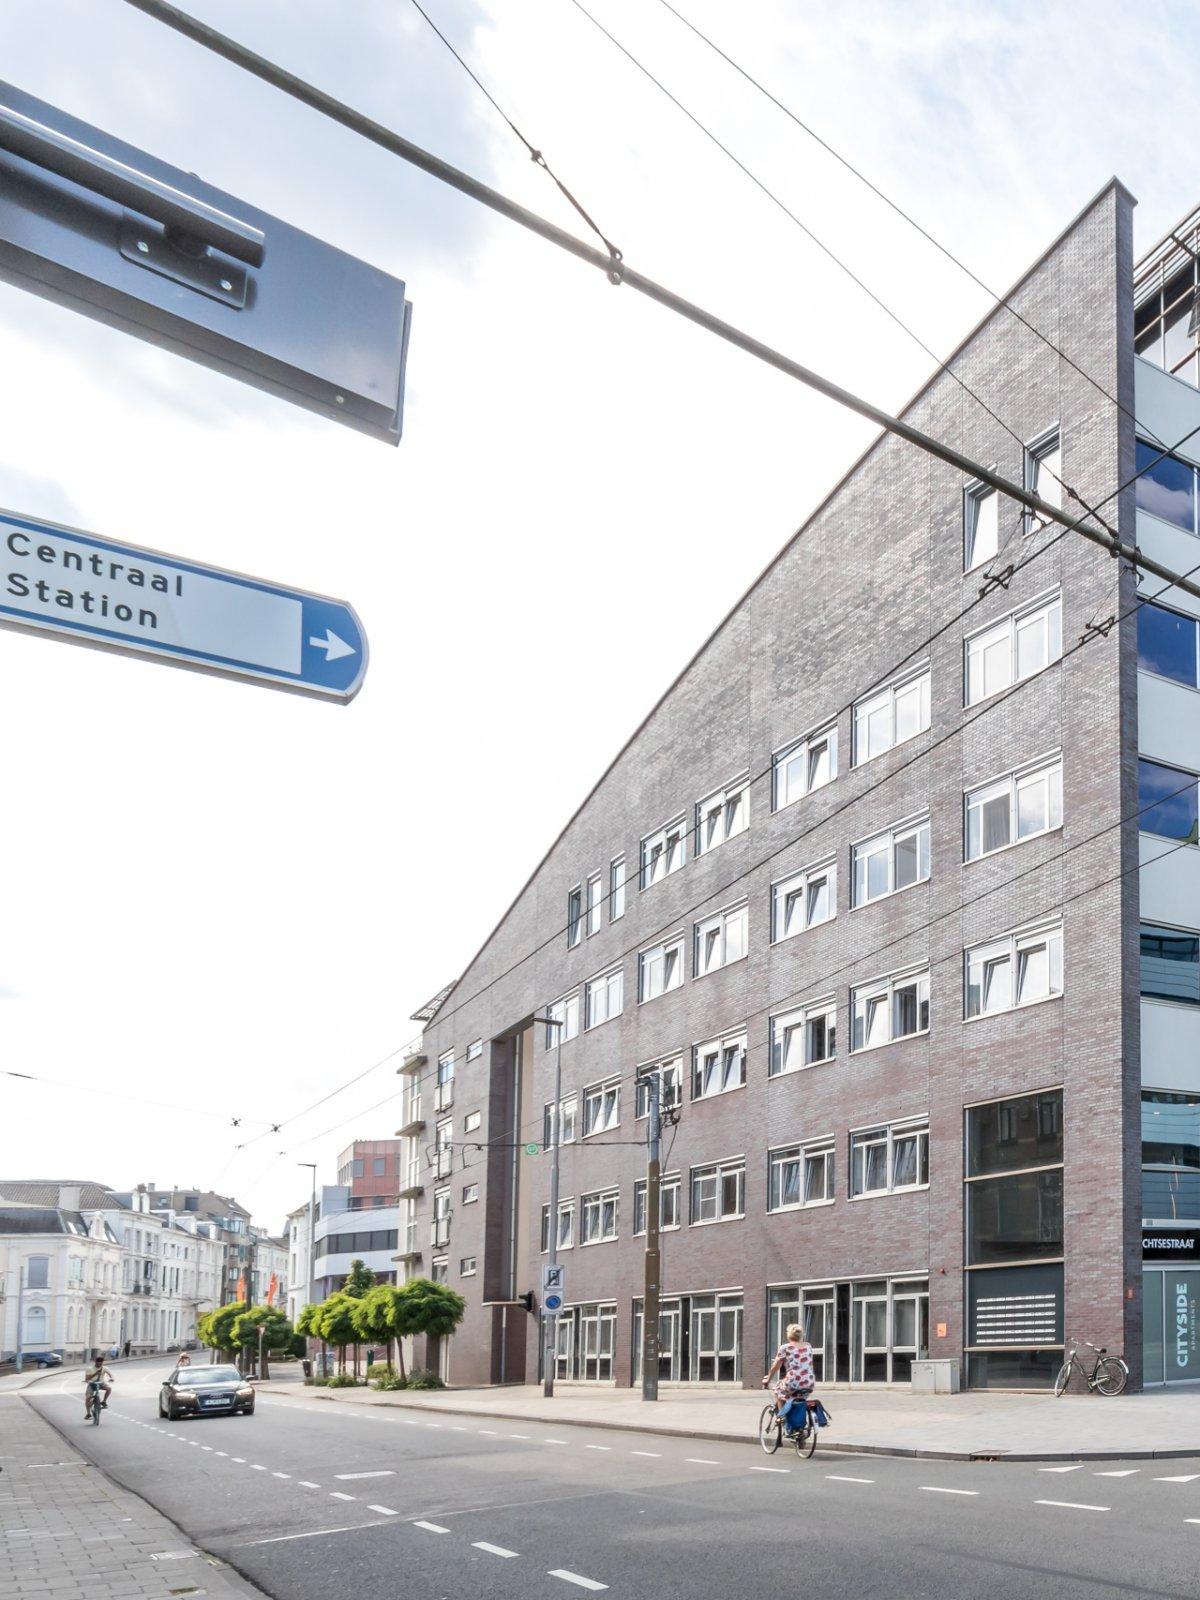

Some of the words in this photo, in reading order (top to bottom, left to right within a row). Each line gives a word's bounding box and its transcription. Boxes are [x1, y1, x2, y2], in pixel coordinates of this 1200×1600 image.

[6, 532, 183, 597] Centraal
[6, 573, 159, 629] Station
[1176, 1283, 1188, 1367] CITYSIDE
